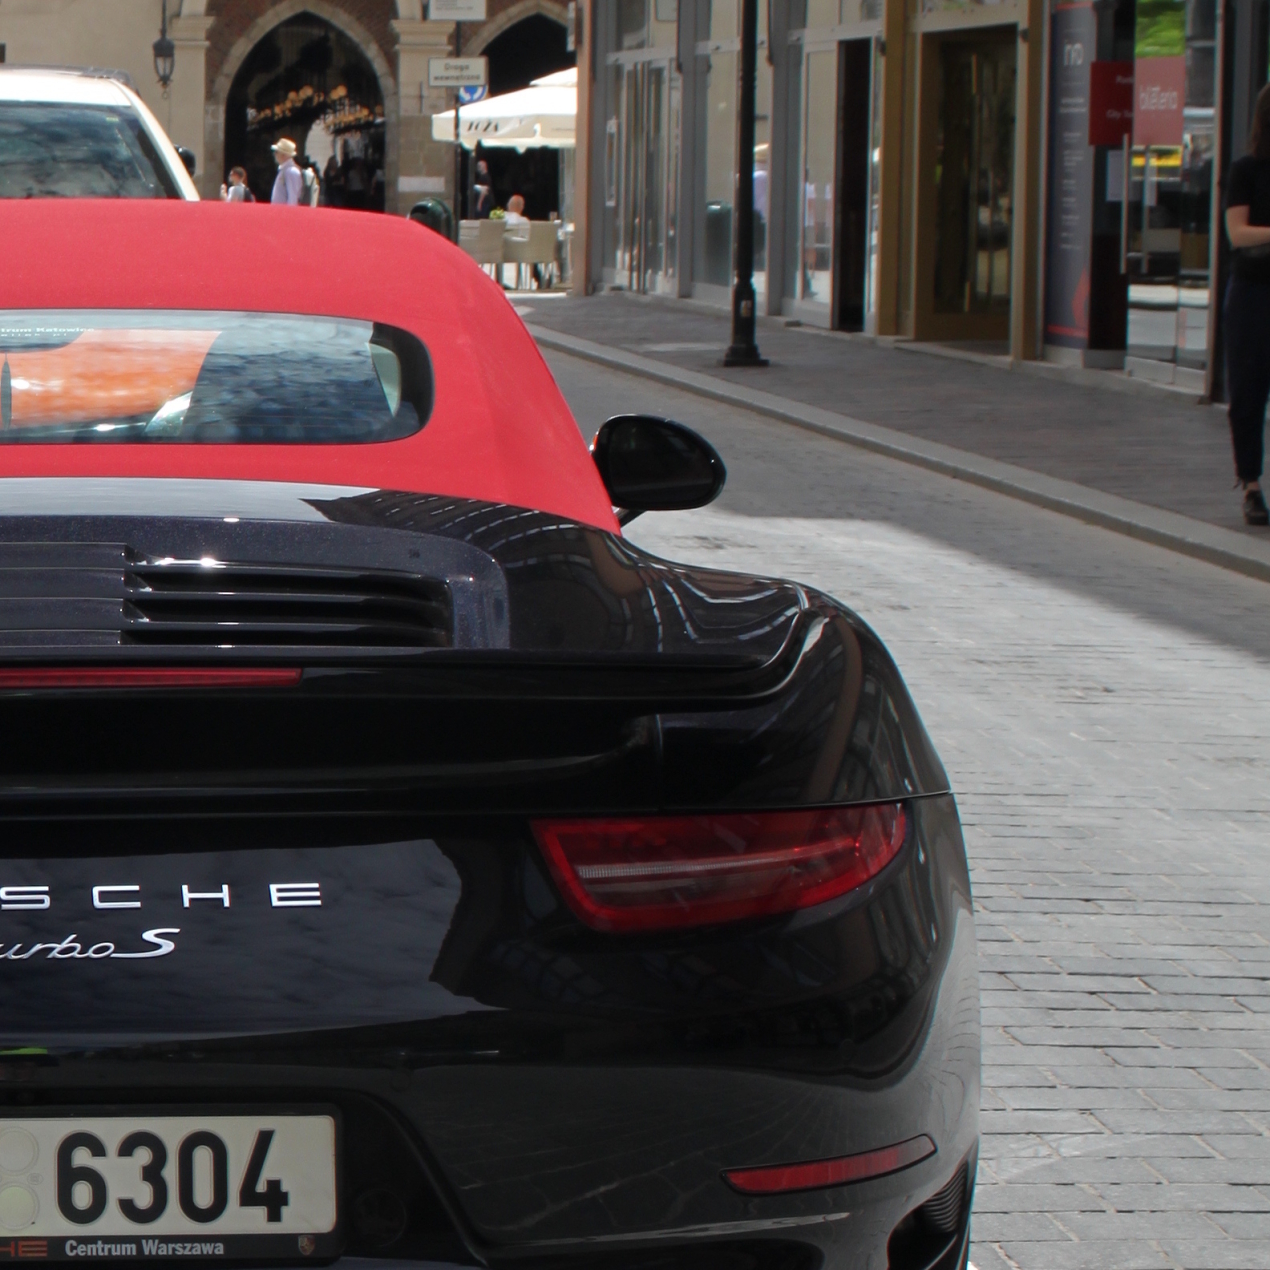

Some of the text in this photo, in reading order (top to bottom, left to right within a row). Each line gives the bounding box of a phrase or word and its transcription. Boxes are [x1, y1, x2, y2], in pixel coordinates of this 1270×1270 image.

[55, 1129, 290, 1225] 6304
[65, 1239, 139, 1258] Centrum
[141, 1239, 225, 1257] Warszawa
